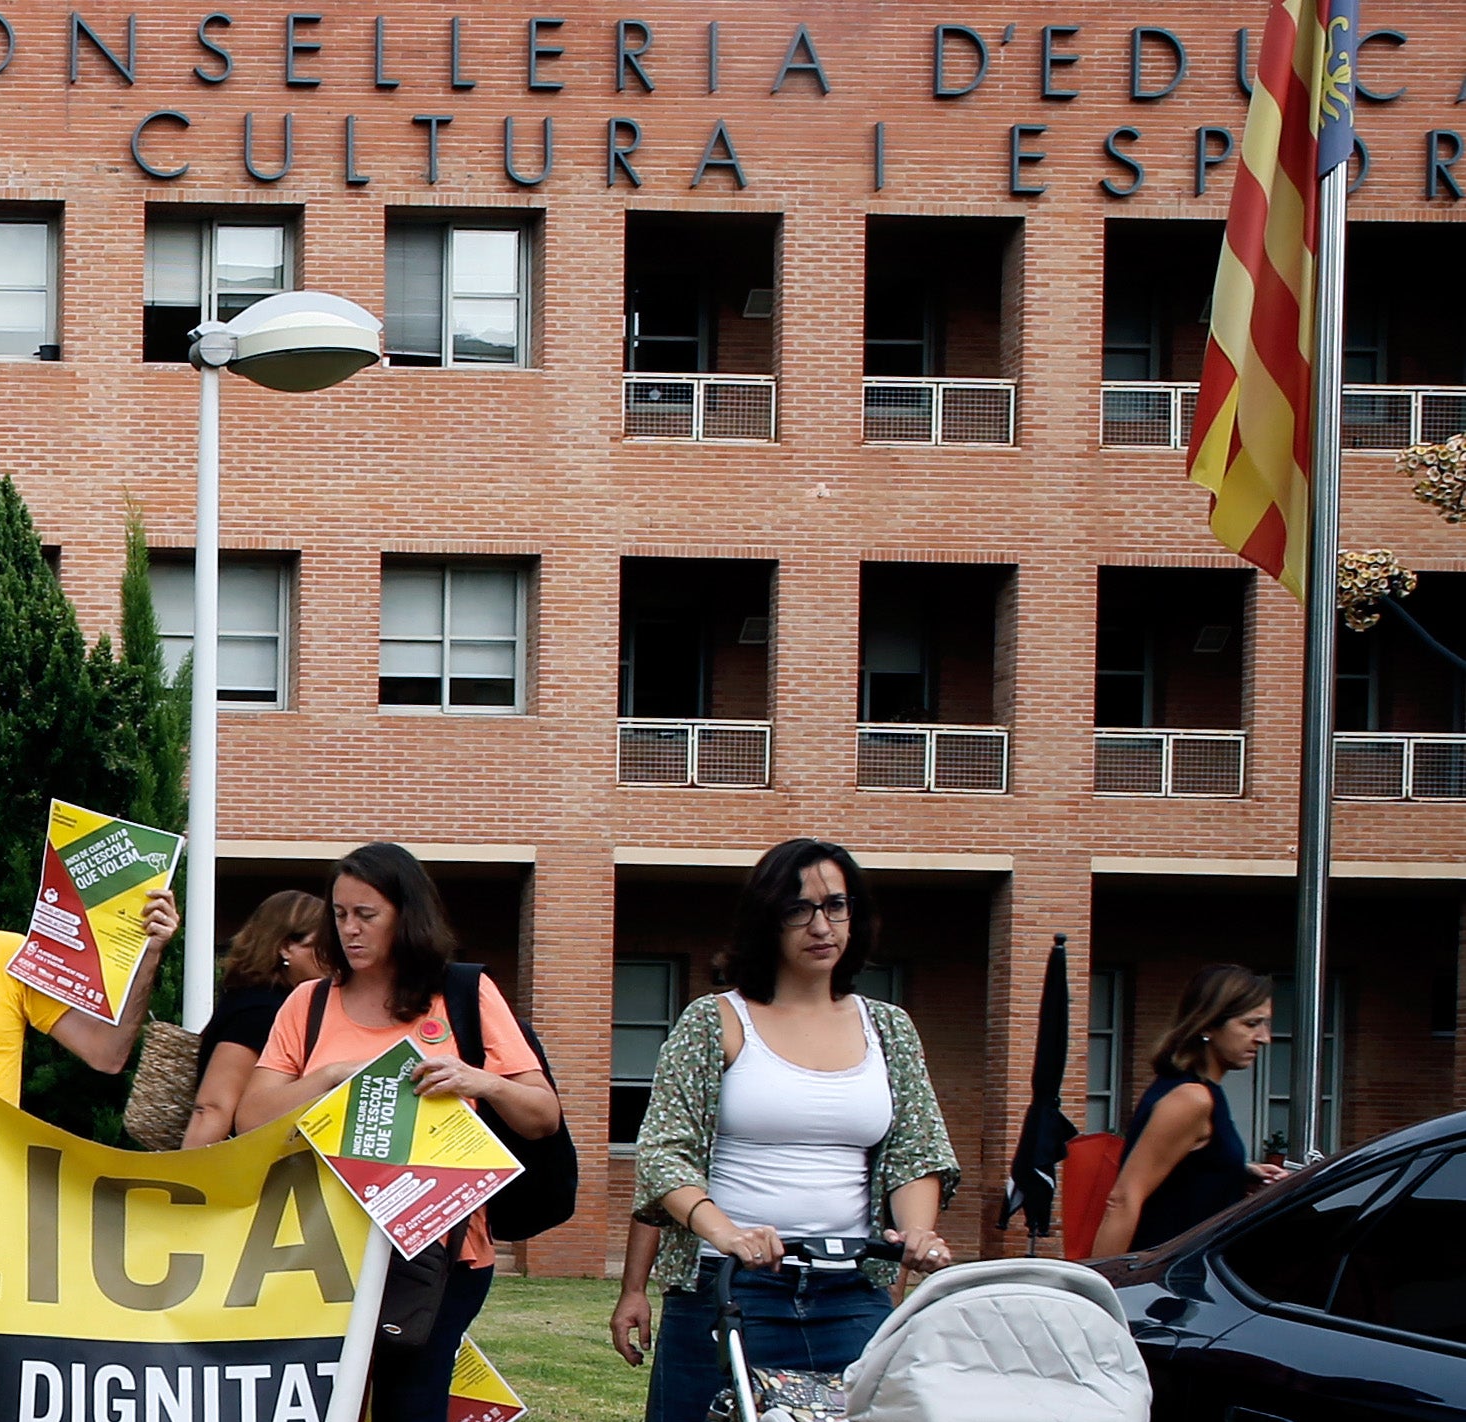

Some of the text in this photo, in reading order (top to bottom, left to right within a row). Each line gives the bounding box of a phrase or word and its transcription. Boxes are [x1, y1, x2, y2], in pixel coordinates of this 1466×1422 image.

[934, 22, 1466, 104] D'EDC
[131, 109, 1466, 201] CULTURA I ESPR
[69, 838, 134, 877] PER L'ESCOLA
[75, 848, 140, 890] QUE VOLEM
[357, 1100, 368, 1122] CURS
[362, 1076, 384, 1157] PER L'ESCOLA
[375, 1078, 399, 1159] QUE VOLEM
